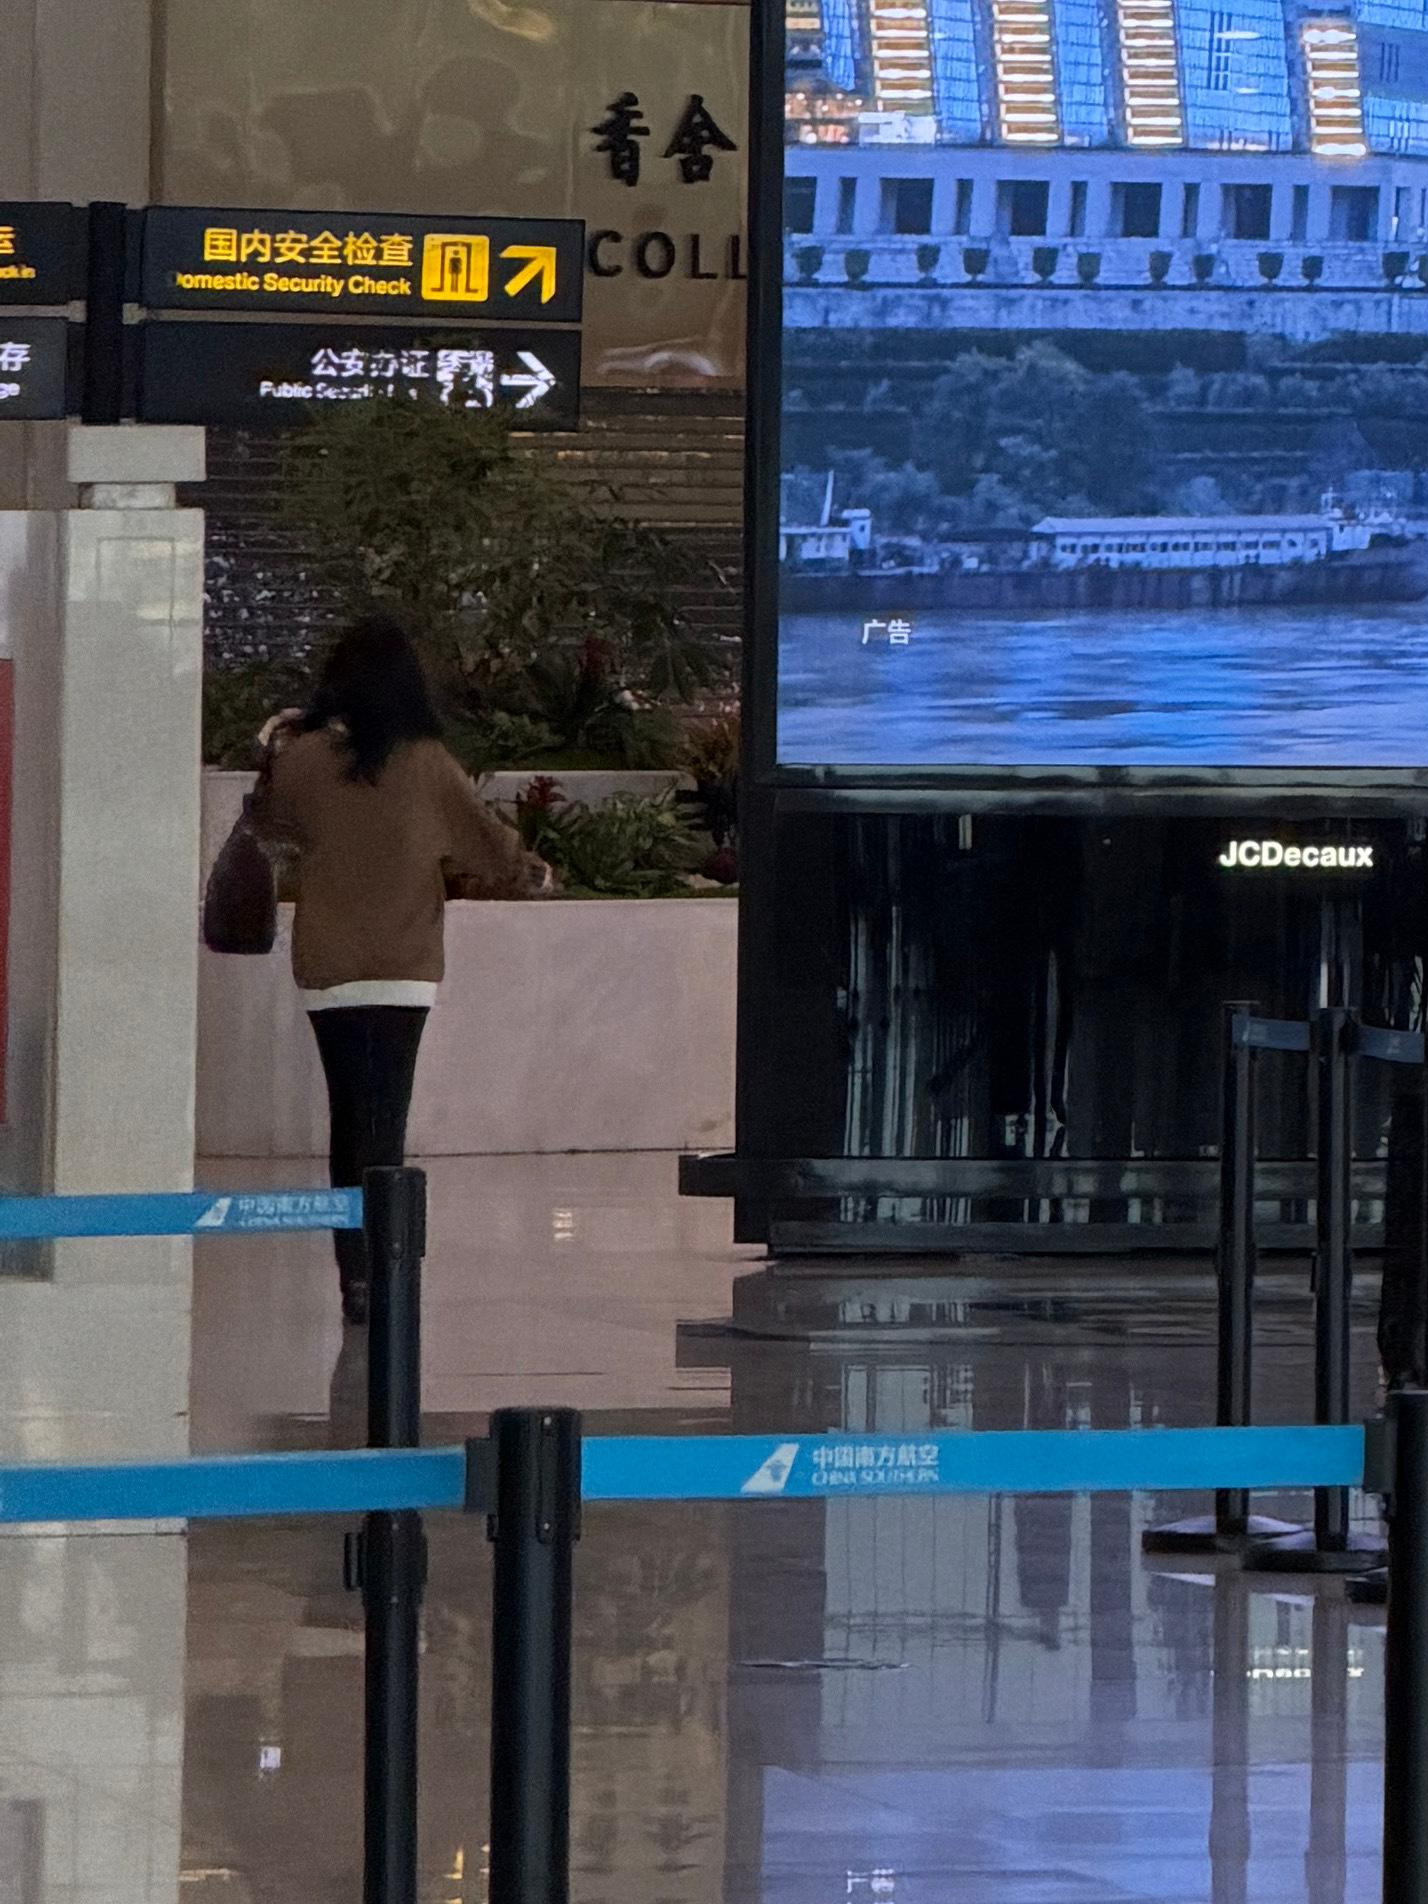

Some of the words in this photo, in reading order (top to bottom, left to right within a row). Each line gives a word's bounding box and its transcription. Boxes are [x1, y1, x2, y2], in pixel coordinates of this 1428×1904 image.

[203, 227, 414, 267] 国内安全检查
[175, 271, 259, 291] omestic
[263, 273, 344, 297] Security
[348, 274, 412, 296] Check
[310, 347, 430, 379] 公安办证
[861, 618, 912, 646] 广告
[1218, 839, 1374, 870] JCDecaux
[812, 1443, 939, 1468] 中国南方航空
